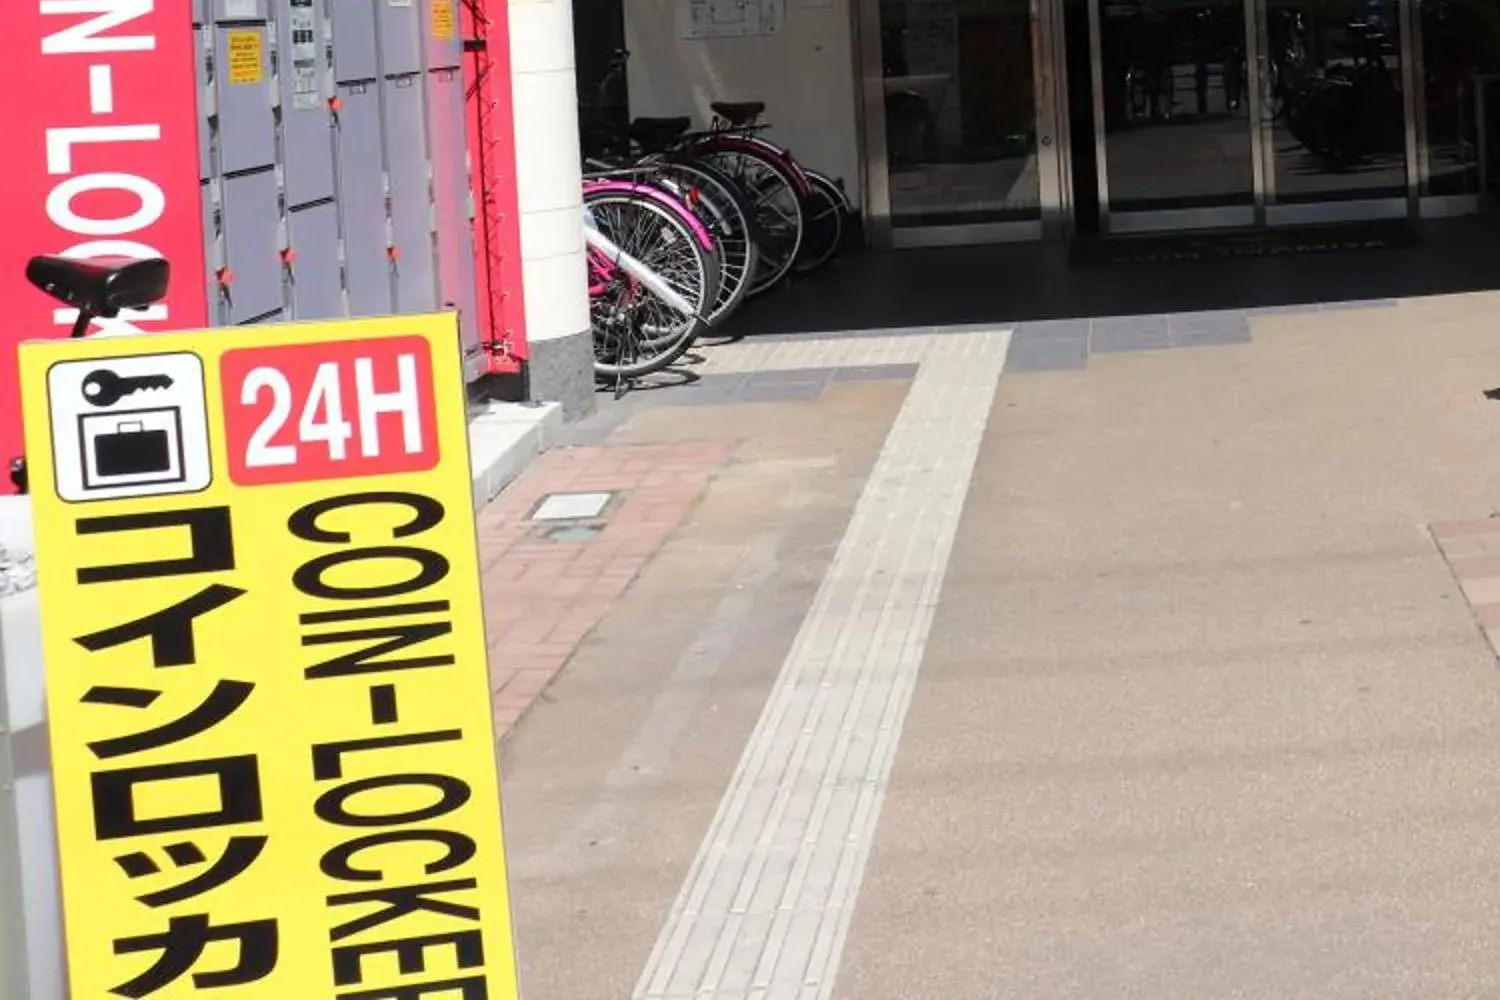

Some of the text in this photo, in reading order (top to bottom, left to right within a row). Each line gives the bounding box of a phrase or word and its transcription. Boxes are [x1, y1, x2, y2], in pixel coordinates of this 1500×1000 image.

[240, 354, 424, 467] 24H
[72, 505, 280, 999] コインロッカ
